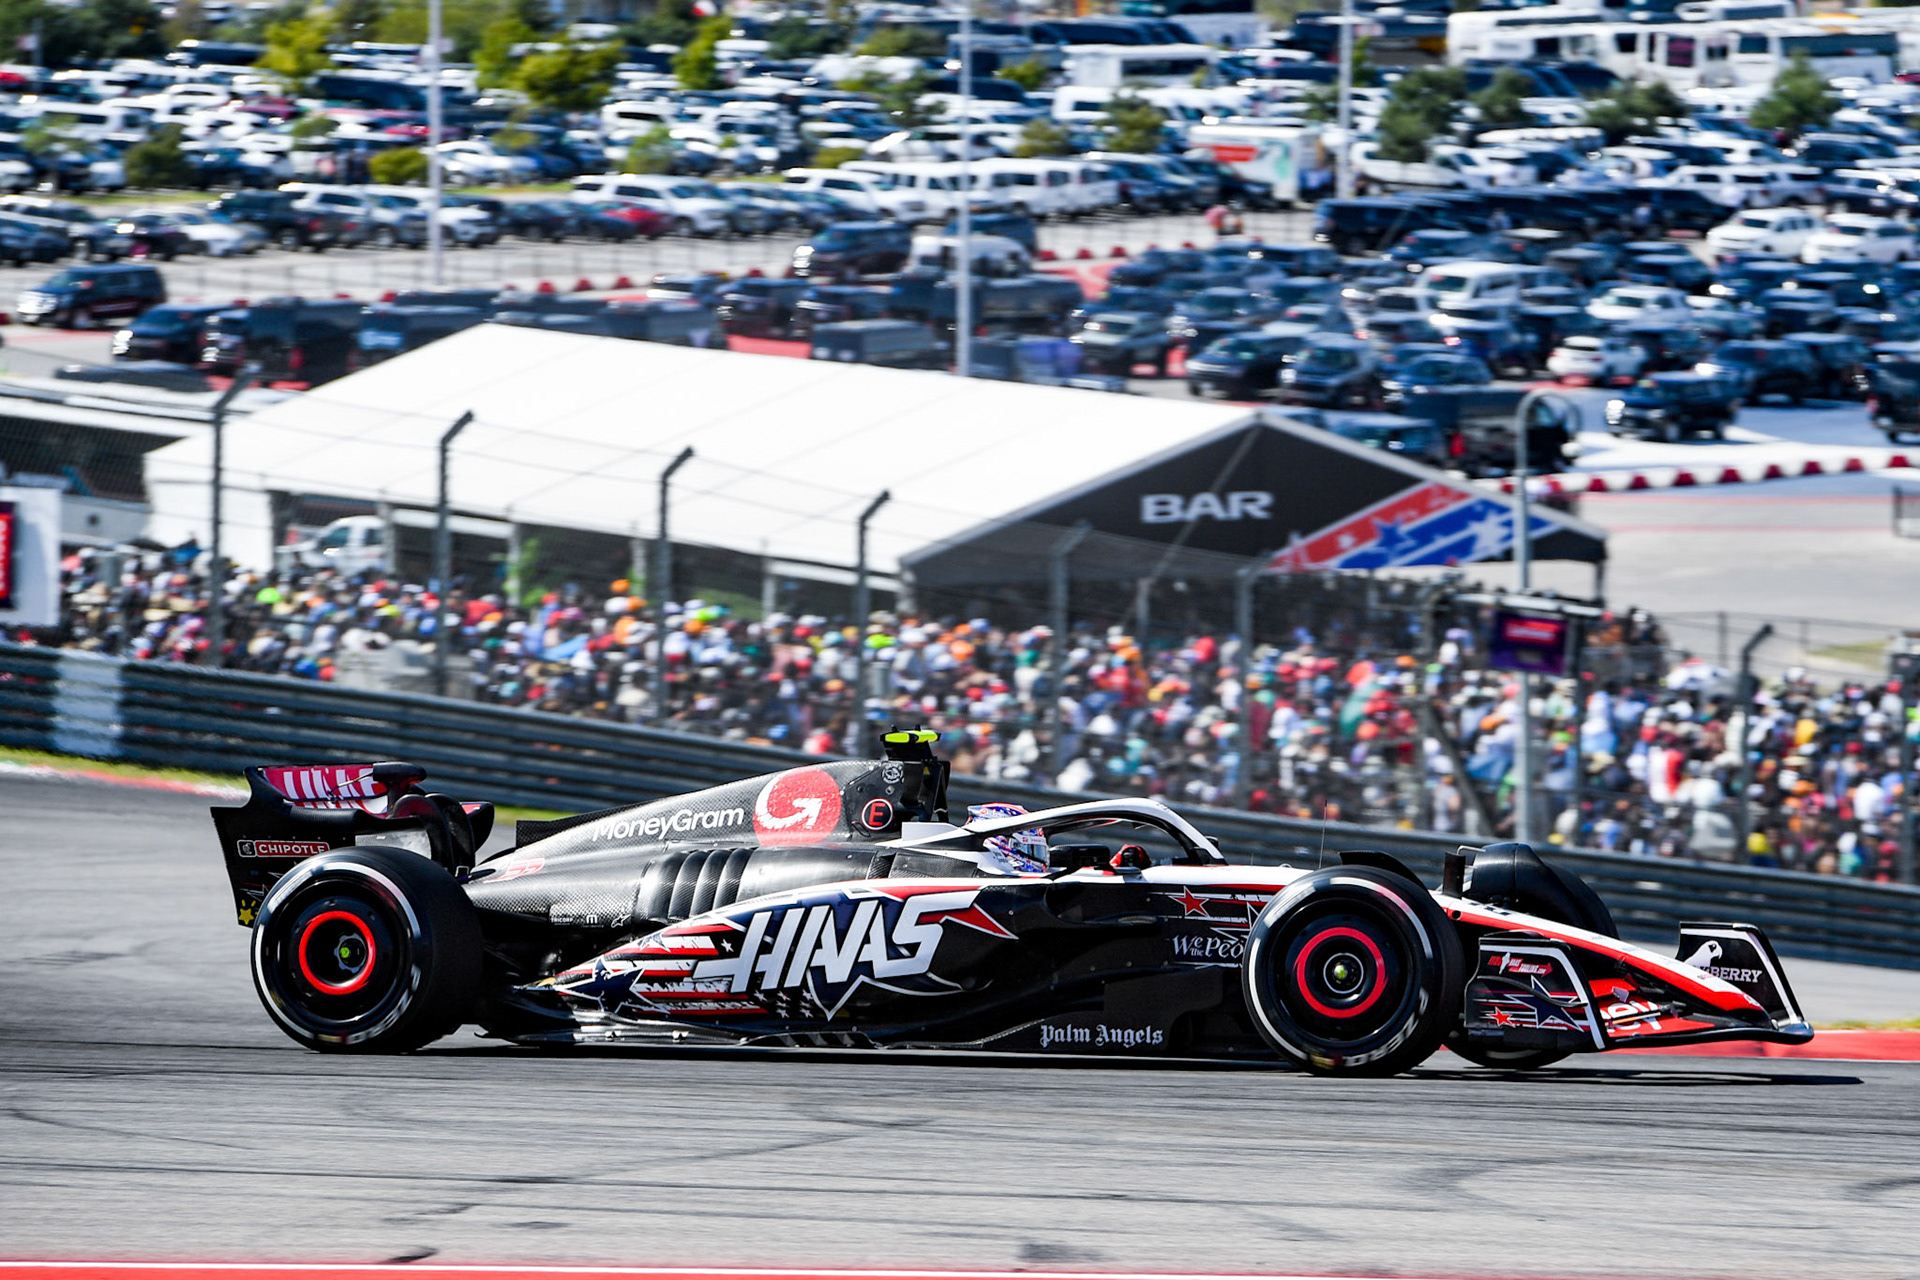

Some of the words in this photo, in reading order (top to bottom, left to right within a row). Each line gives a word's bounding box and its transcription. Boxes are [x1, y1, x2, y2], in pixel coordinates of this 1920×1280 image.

[1142, 491, 1273, 523] BAR
[592, 807, 744, 841] MoneyGram
[868, 802, 886, 827] E
[692, 889, 982, 994] HAAS
[1172, 934, 1204, 955] We
[1700, 966, 1762, 983] BERRY
[1040, 1023, 1091, 1048] Palm
[1095, 1024, 1163, 1048] Angels
